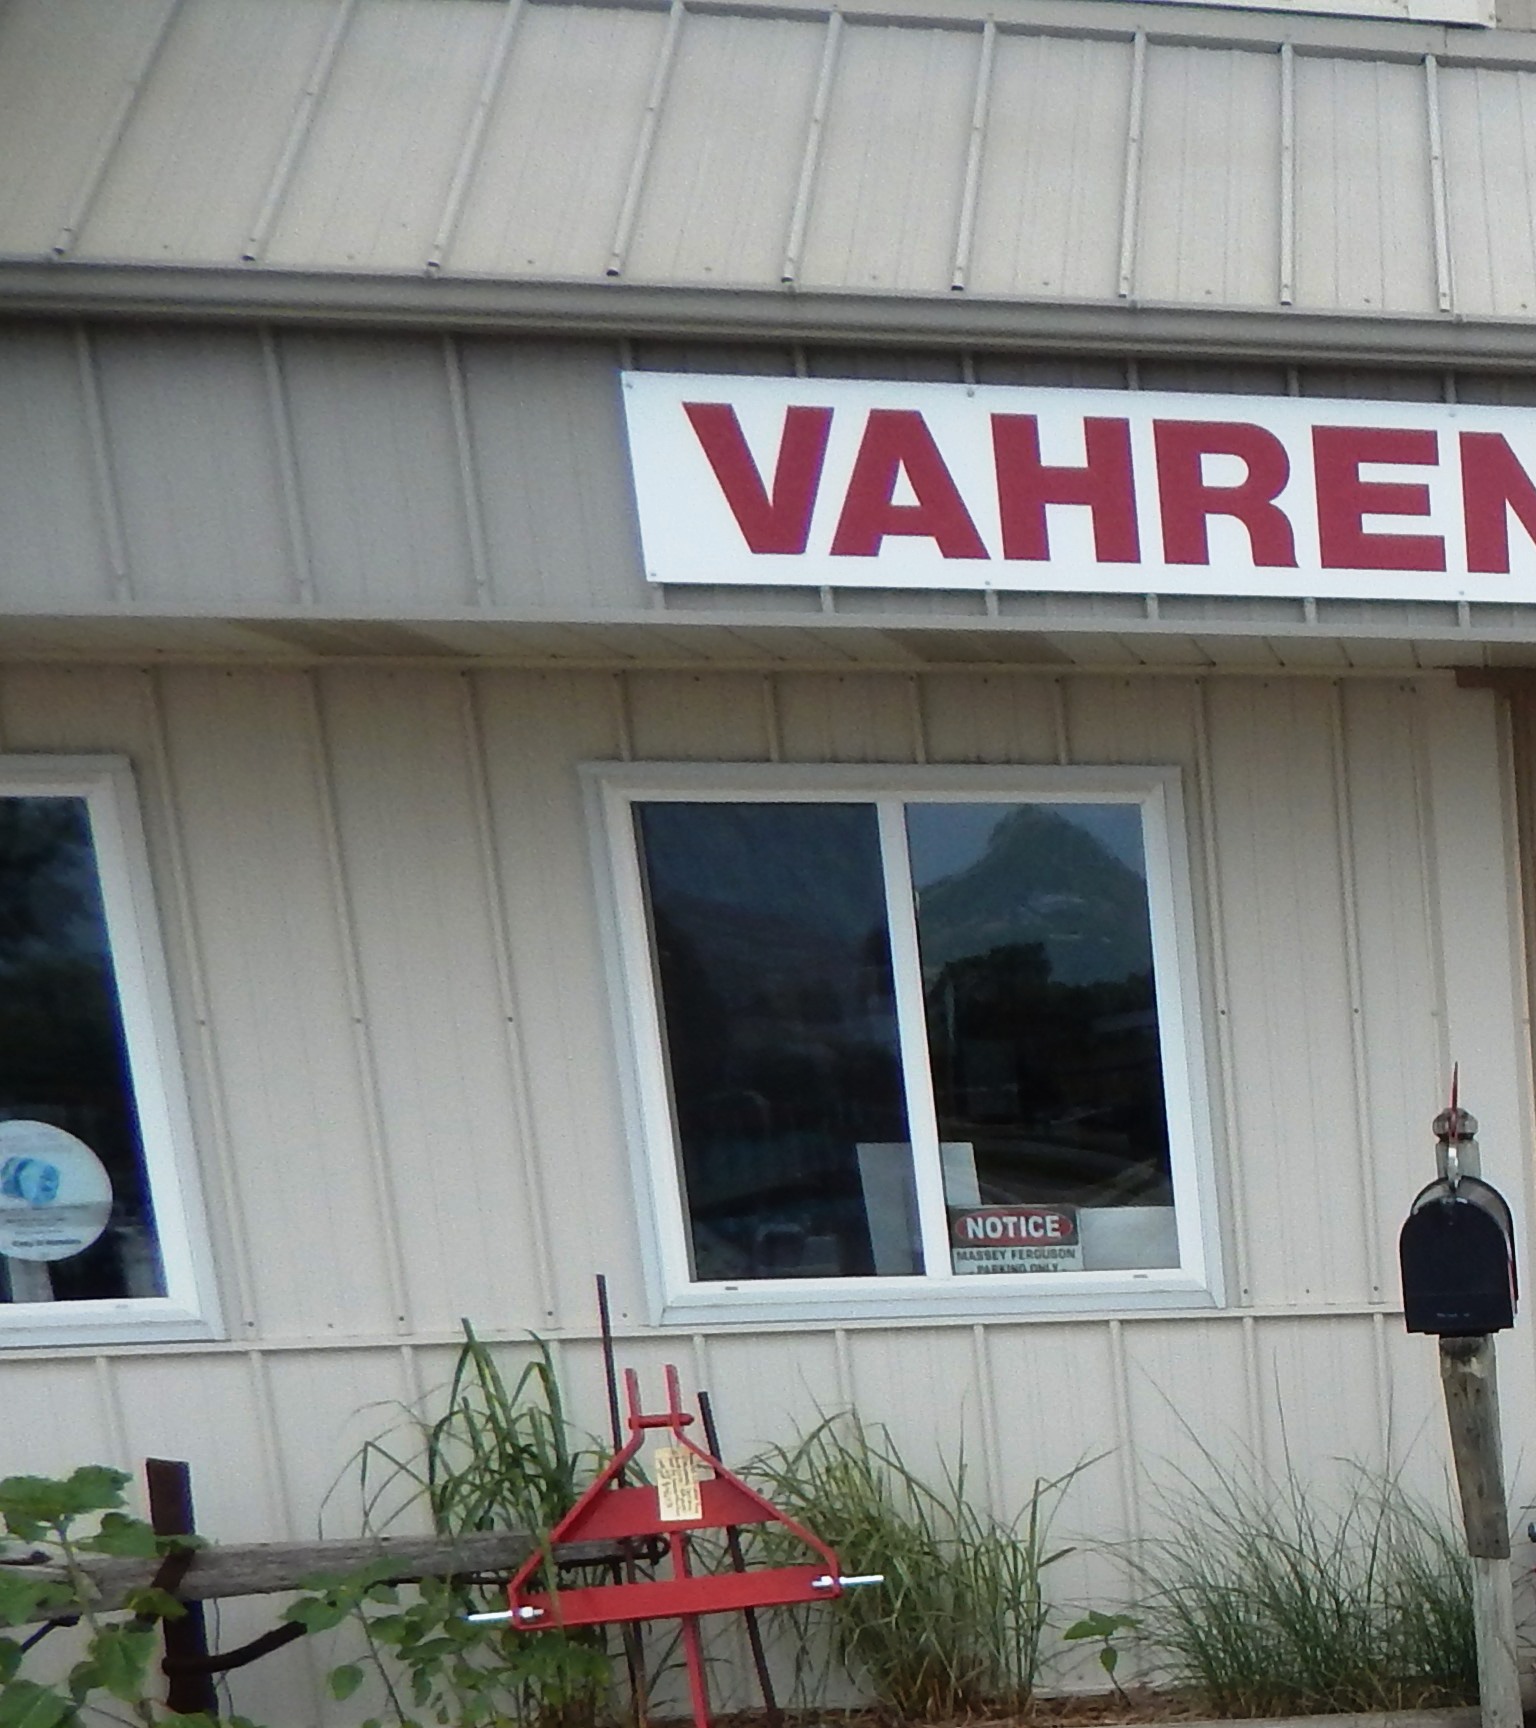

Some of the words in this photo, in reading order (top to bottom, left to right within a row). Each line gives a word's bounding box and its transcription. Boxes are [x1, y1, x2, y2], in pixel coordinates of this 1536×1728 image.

[966, 1214, 1062, 1239] NOTICE
[956, 1249, 1007, 1261] MASSEY
[1011, 1248, 1076, 1260] FERGUSON
